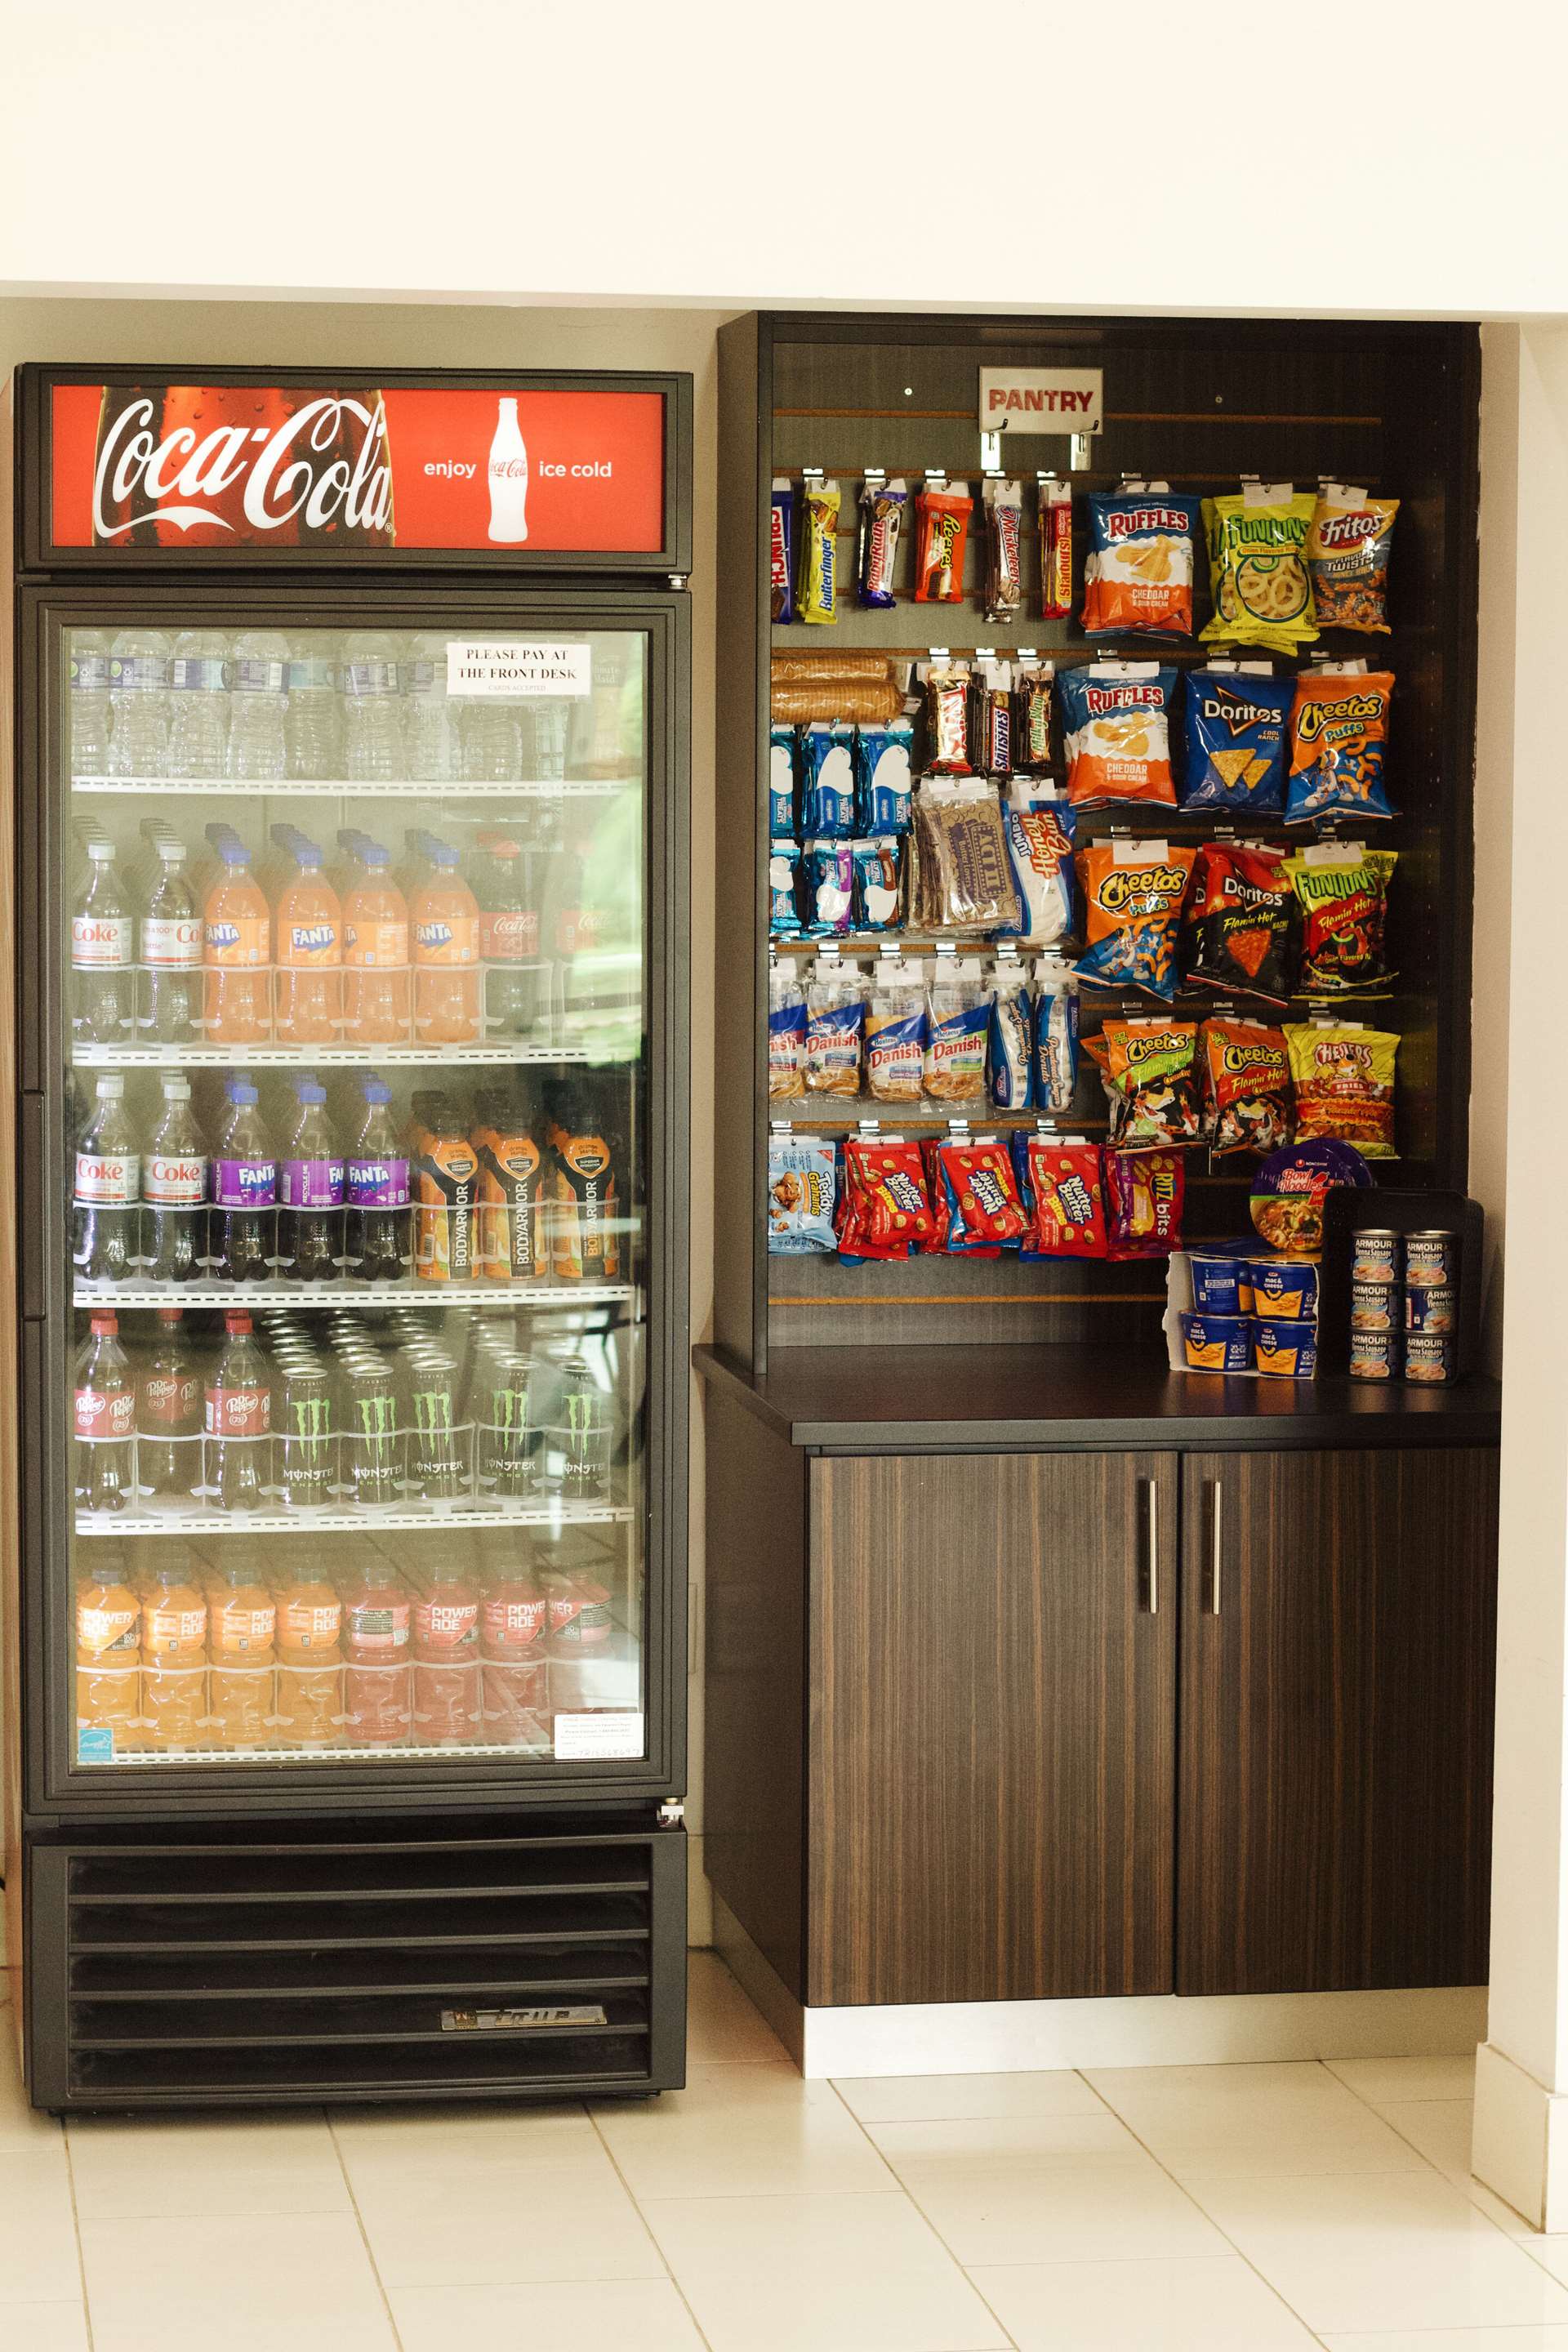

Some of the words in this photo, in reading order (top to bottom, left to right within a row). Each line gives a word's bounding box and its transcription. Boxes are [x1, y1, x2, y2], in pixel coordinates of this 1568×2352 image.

[988, 389, 1094, 412] PANTRY
[94, 397, 394, 539] Coca-Cola
[424, 459, 477, 479] enjoy
[539, 461, 566, 478] ice
[571, 461, 612, 478] cold
[1002, 506, 1015, 517] 3
[1109, 509, 1188, 538] RUFFLES
[939, 512, 962, 571] Reese's
[1321, 514, 1383, 546] Fritos
[1001, 517, 1021, 587] Musketeers
[1326, 557, 1374, 572] TWISTS
[819, 537, 835, 611] Butterfinger
[1059, 538, 1071, 599] Starburst
[1132, 589, 1169, 600] CHEDDAR
[466, 648, 519, 660] PLEASE
[523, 649, 549, 660] PAY
[552, 650, 569, 661] AT
[458, 668, 486, 679] THE
[490, 668, 537, 679] FRONT
[540, 669, 577, 679] DESK
[1087, 686, 1164, 714] RUFFLES
[1204, 699, 1282, 724] Doritos
[1300, 696, 1383, 736] Cheetos
[995, 710, 1009, 771] SATISFIES
[1325, 722, 1365, 741] Puffs
[1107, 763, 1148, 774] CHEDDAR
[1012, 811, 1031, 858] JUMBO
[1022, 813, 1059, 877] Honey
[1043, 811, 1071, 861] Bun
[978, 833, 997, 866] ACT
[1100, 867, 1186, 907] Cheetos
[1223, 877, 1284, 906] Doritos
[1296, 871, 1379, 901] FUNYUNS
[1354, 898, 1374, 914] Hot
[72, 920, 118, 942] Coke
[290, 924, 336, 946] FANTA
[1223, 914, 1257, 932] Flamin'
[1258, 911, 1278, 924] Hot
[805, 1032, 859, 1054] Danish
[871, 1042, 922, 1069] Danish
[933, 1036, 982, 1061] Danish
[1127, 1032, 1188, 1063] Cheetos
[1038, 1044, 1050, 1085] Donuts
[1225, 1045, 1284, 1072] Cheetos
[1231, 1073, 1265, 1093] Flamin'
[1267, 1069, 1284, 1083] Hot
[77, 1158, 123, 1180] Coke
[152, 1160, 200, 1182] Coke
[349, 1165, 390, 1183] FANTA
[993, 1166, 1012, 1197] Bites
[1282, 1169, 1312, 1181] Bowl
[807, 1171, 821, 1217] Grahams
[819, 1171, 835, 1216] Teddy
[875, 1184, 899, 1214] Bites
[886, 1176, 916, 1214] Butter
[894, 1172, 924, 1209] Nutter
[969, 1175, 999, 1215] Nutter
[976, 1170, 1008, 1206] Butter
[1067, 1175, 1094, 1219] Nutter
[1154, 1172, 1174, 1201] RITZ
[1279, 1179, 1324, 1192] Noodles
[1048, 1194, 1068, 1226] Bites
[1058, 1182, 1085, 1225] Butter
[1156, 1203, 1172, 1236] bits
[1355, 1239, 1392, 1248] ARMOUR
[1407, 1242, 1443, 1251] ARMOUR
[1352, 1285, 1388, 1295] ARMOUR
[1427, 1290, 1454, 1299] ARMO
[1352, 1335, 1388, 1345] ARMOUR
[1407, 1338, 1443, 1348] ARMOUR
[431, 1618, 461, 1631] ADE
[432, 1605, 478, 1619] POWER
[507, 1615, 535, 1628] ADE
